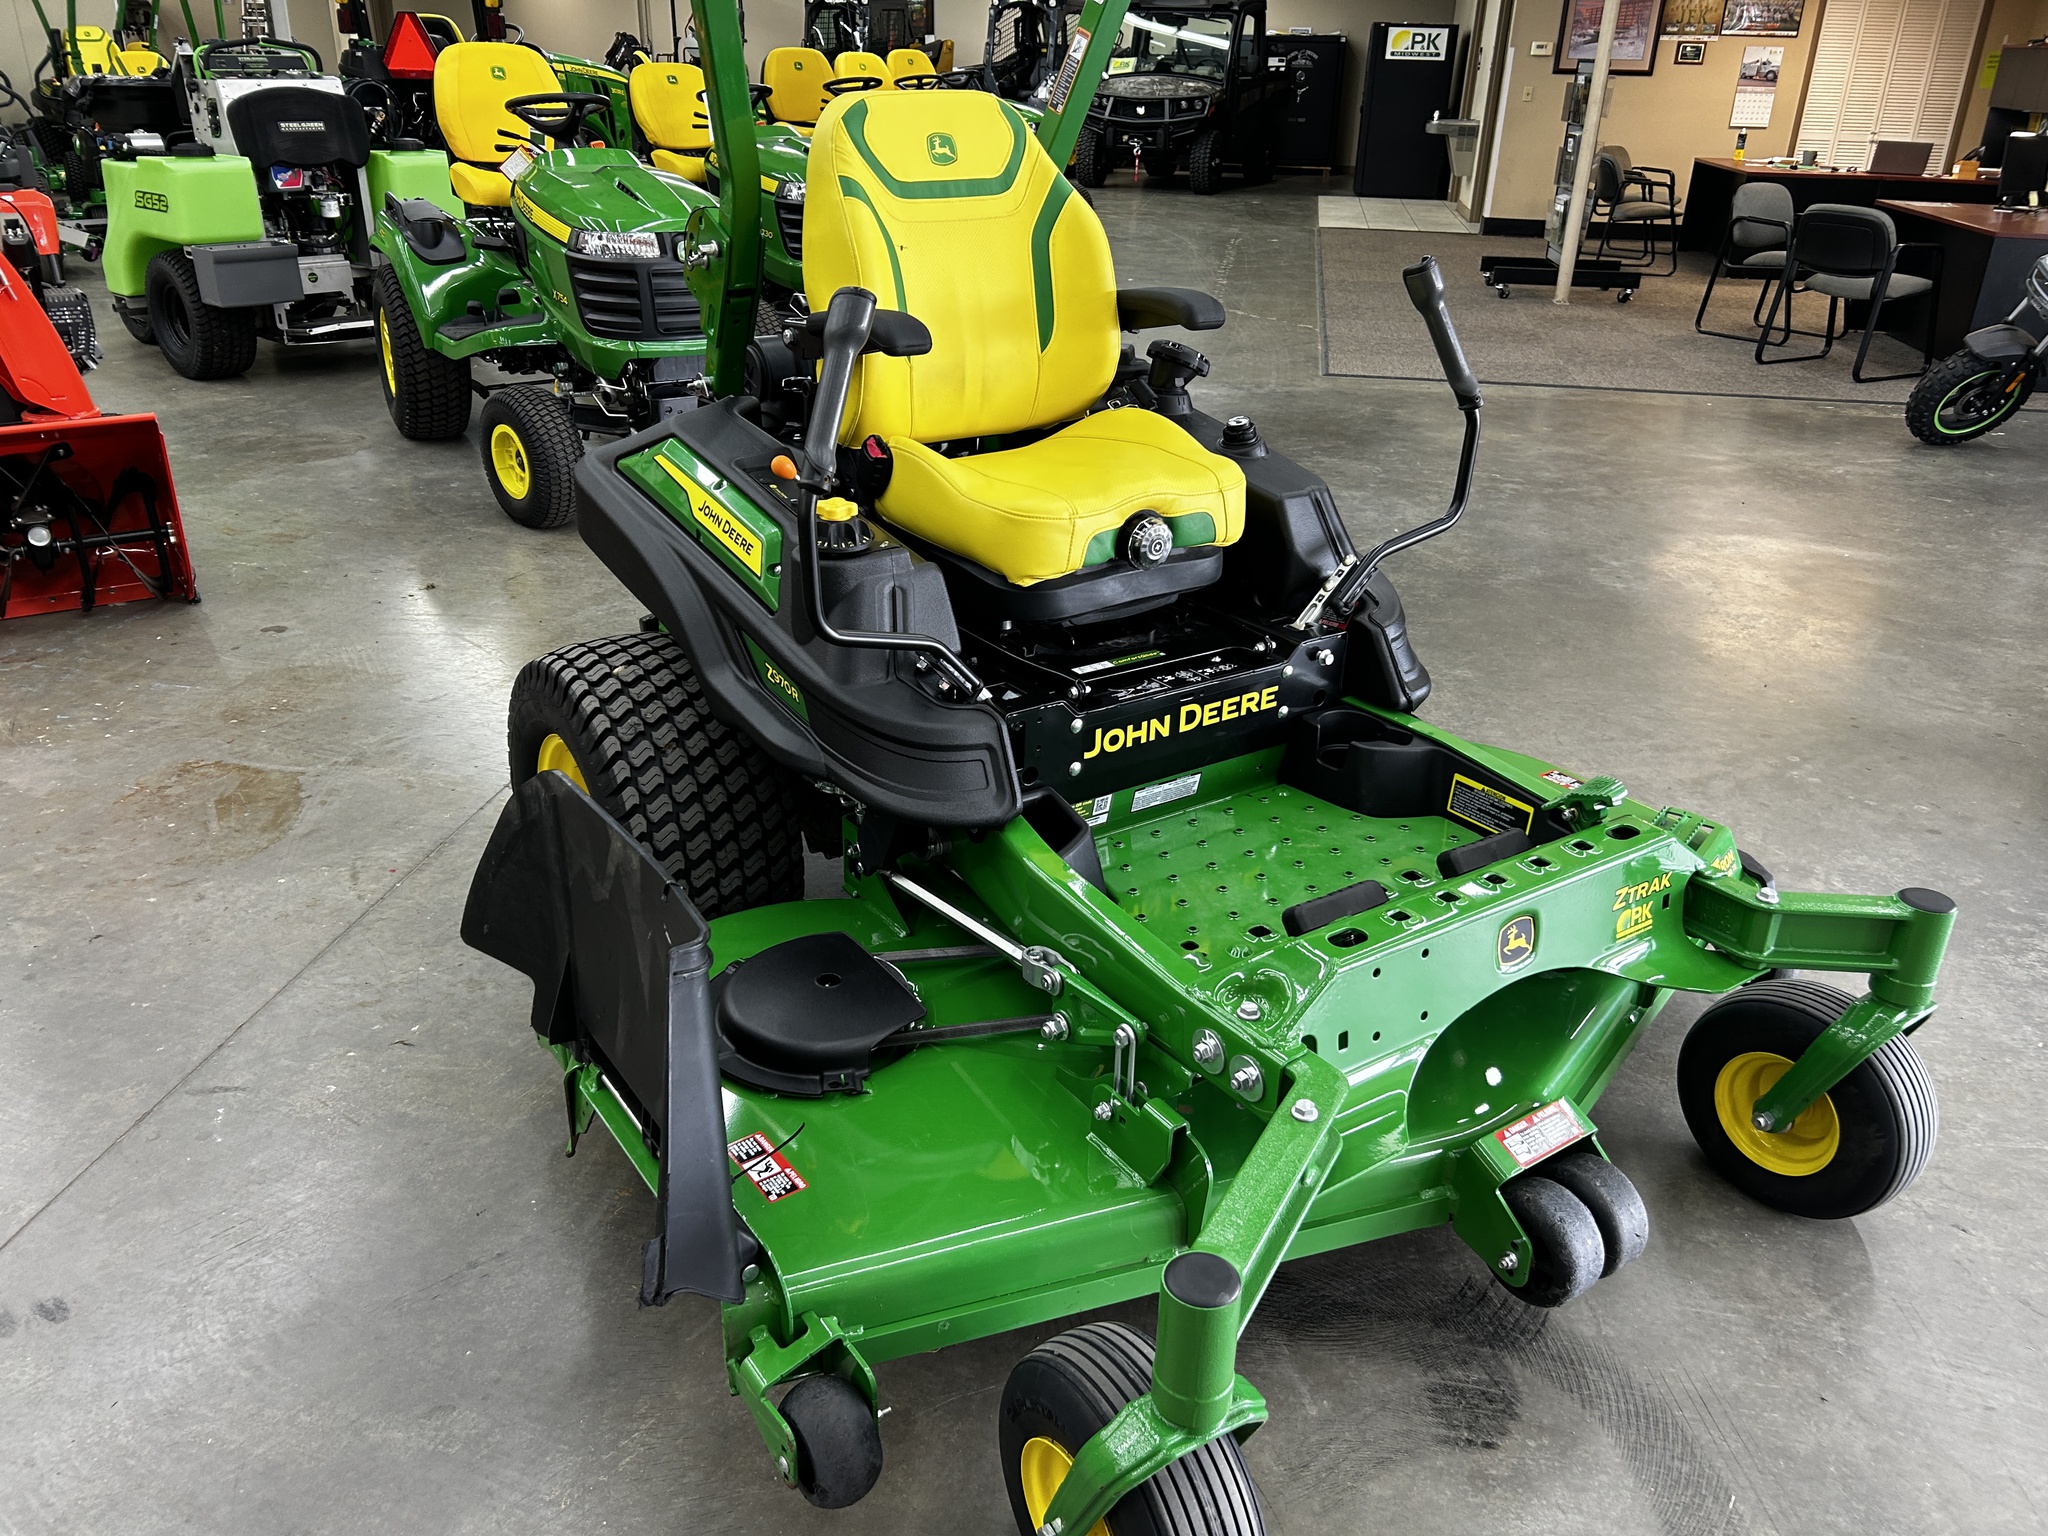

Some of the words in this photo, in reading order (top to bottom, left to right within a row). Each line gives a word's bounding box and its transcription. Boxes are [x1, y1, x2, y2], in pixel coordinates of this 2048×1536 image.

[1410, 32, 1441, 50] P&K
[582, 68, 599, 76] DEERE
[134, 190, 168, 213] SG52
[698, 501, 723, 528] JOHN
[722, 520, 754, 556] DEERE
[765, 662, 799, 702] Z970R
[1084, 715, 1170, 760] JOHN
[1179, 686, 1278, 732] DEERE
[1612, 872, 1672, 911] ZTRAK
